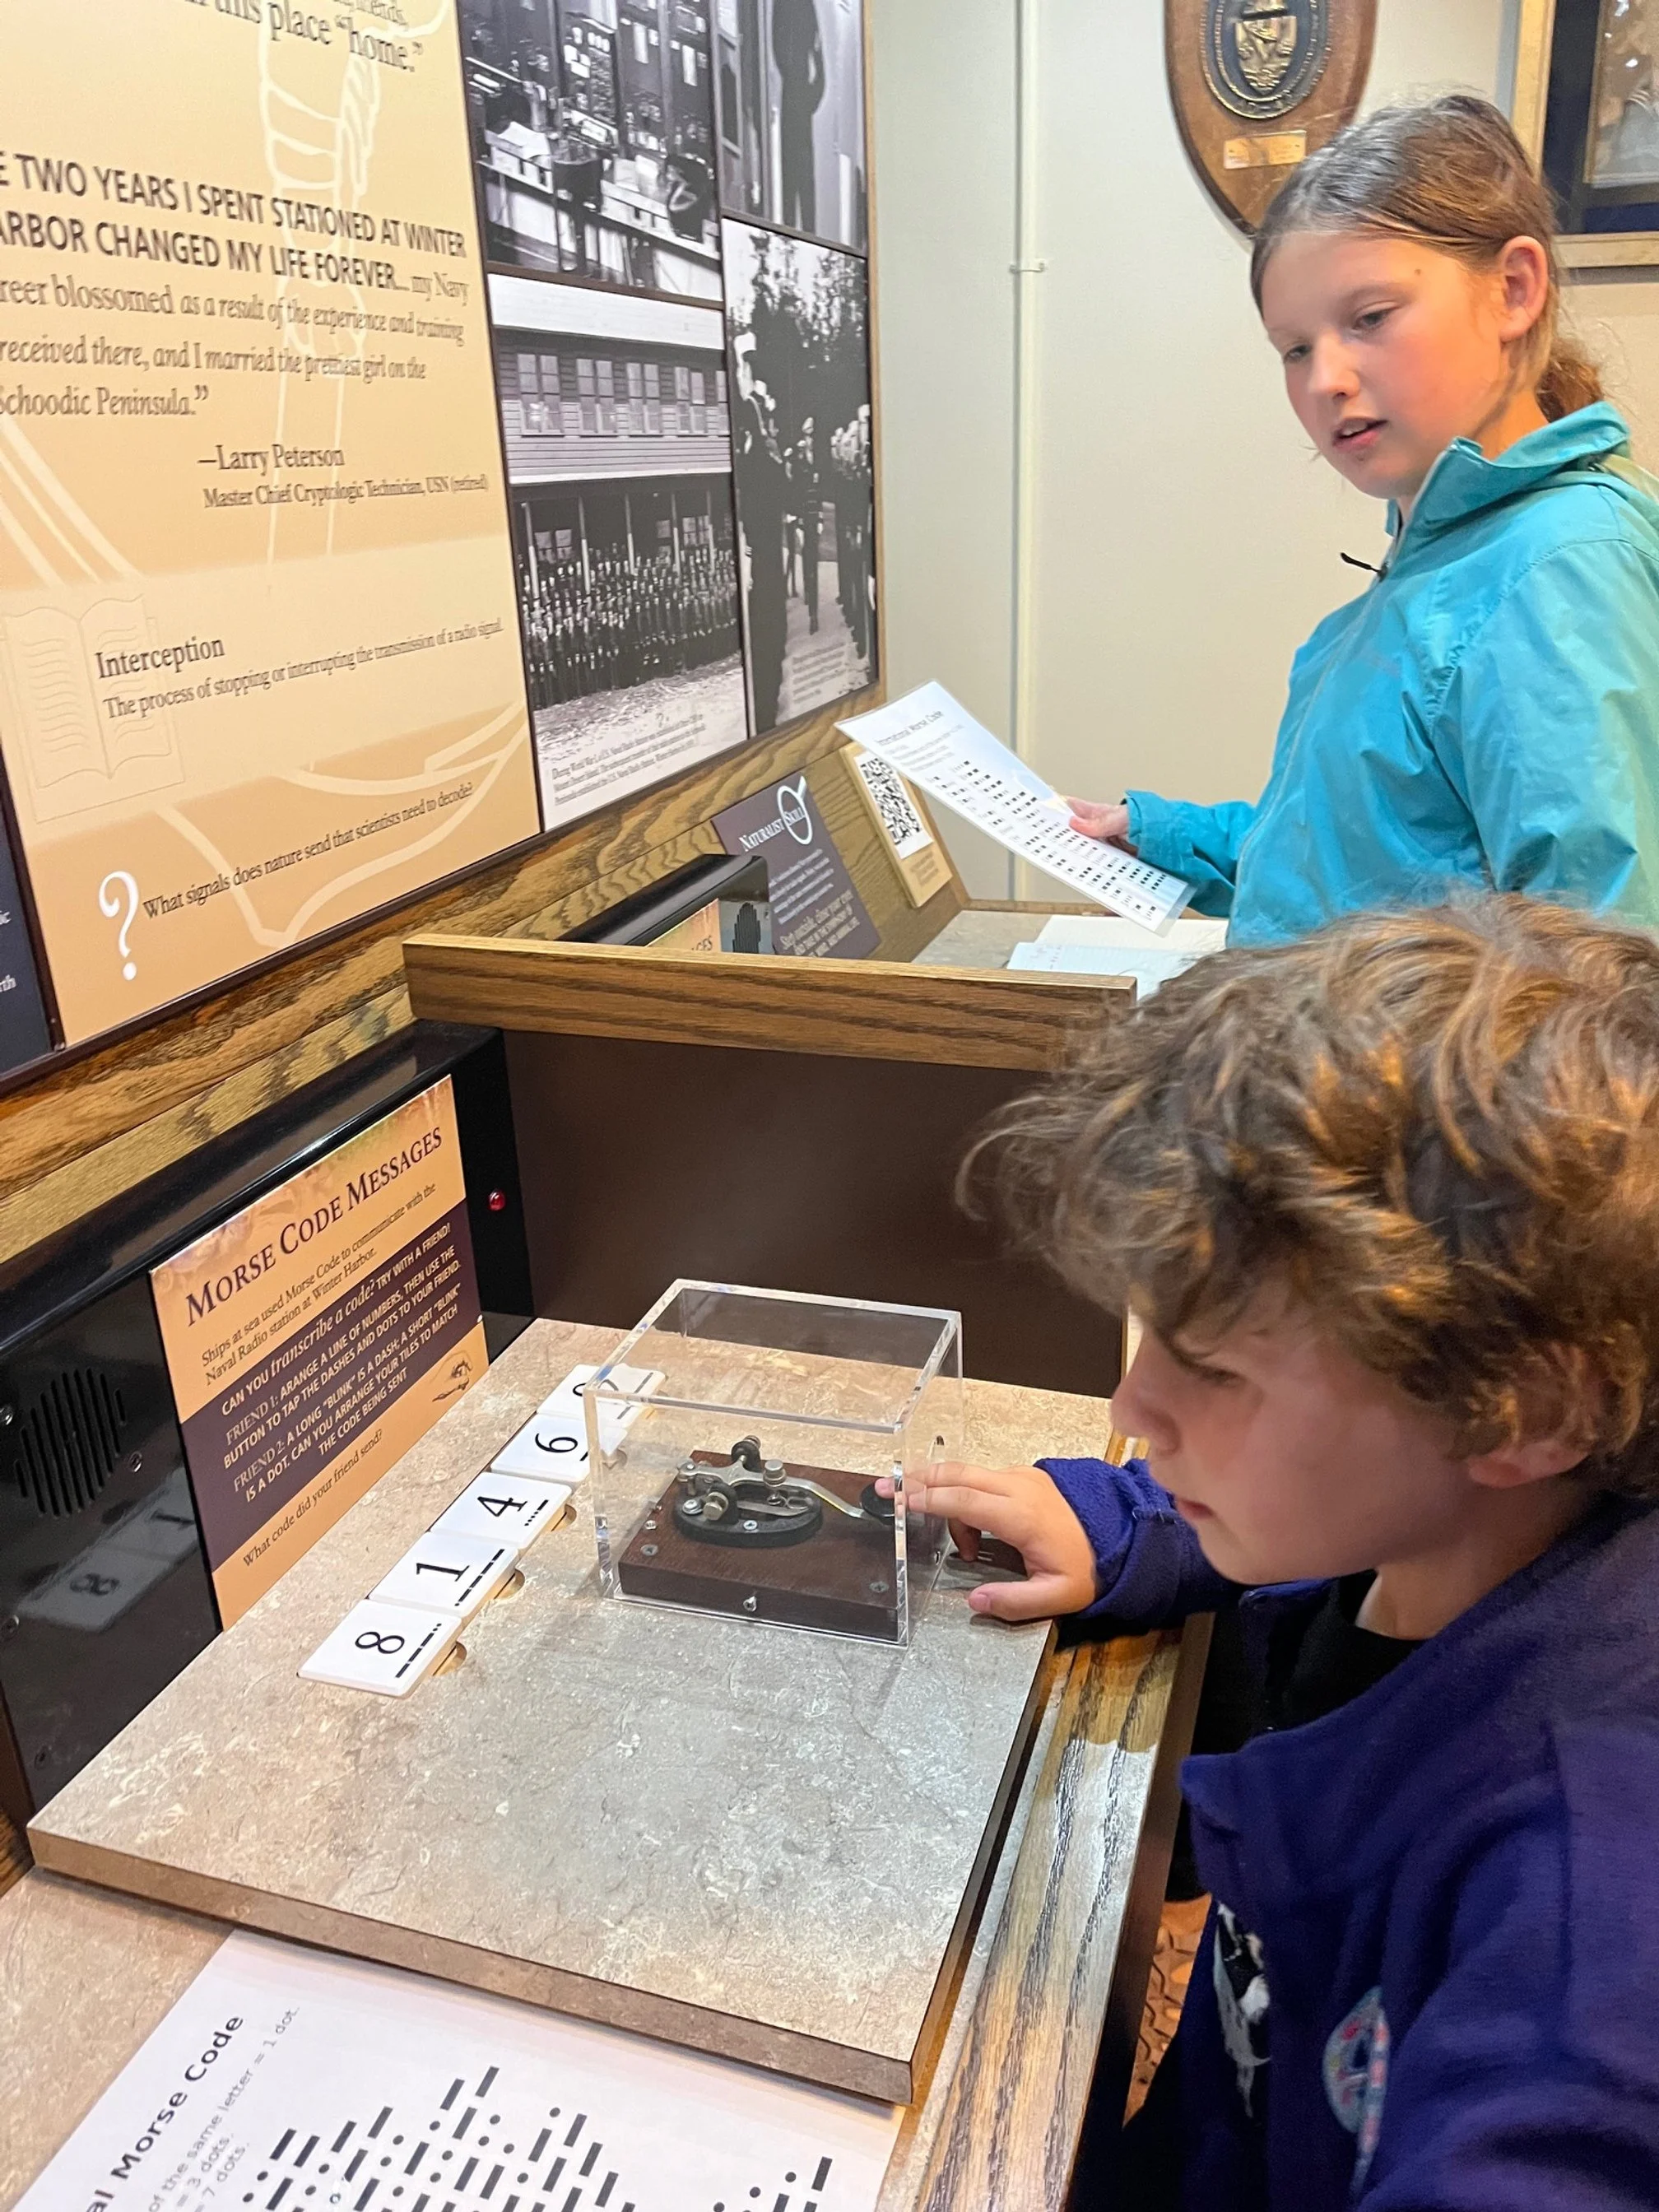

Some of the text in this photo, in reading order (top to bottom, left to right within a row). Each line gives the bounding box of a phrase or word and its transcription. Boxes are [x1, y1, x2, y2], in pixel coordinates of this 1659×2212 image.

[268, 0, 332, 44] place
[12, 153, 87, 197] TWO
[93, 165, 179, 210] YEARS
[183, 181, 193, 213] I
[197, 184, 264, 224] SPENT
[270, 197, 376, 242] STATIONED
[381, 218, 401, 247] AT
[404, 222, 467, 258] WINTER
[50, 273, 175, 314] blossomed
[180, 294, 200, 315] as
[203, 297, 216, 316] a
[219, 294, 264, 321] result
[267, 296, 286, 331] of
[286, 296, 310, 325] the
[313, 305, 387, 334] experience
[389, 311, 414, 333] and
[95, 221, 470, 307] CHANGED MY LIFE Navy
[0, 333, 87, 364] received
[92, 336, 150, 371] there,
[153, 341, 190, 368] and
[205, 346, 275, 372] married
[278, 347, 302, 373] the
[363, 354, 386, 384] girl
[388, 361, 406, 379] on
[407, 356, 426, 379] the
[203, 486, 253, 508] Master
[256, 483, 292, 504] Chief
[272, 444, 346, 469] Peterson
[94, 635, 225, 679] Interception
[102, 696, 137, 719] The
[138, 685, 195, 718] process
[196, 677, 212, 699] of
[213, 669, 272, 698] stopping
[272, 667, 286, 683] or
[287, 651, 356, 679] interrupting
[356, 645, 374, 663] the
[142, 781, 473, 919] What signals does nature send that scientists need decode?
[185, 1127, 442, 1327] MORSE CODE MESSAGES
[202, 1183, 437, 1367] Ships at sea used Morse Code to communicate with the
[206, 1248, 377, 1386] Naval Radio station at Winter Harbor.
[221, 1222, 451, 1415] CAN YOU transcribe a code? TRY WITH A FRIEND!
[224, 1260, 462, 1469] BUTTON TO TAP THE DASHES AND DOTS TO YOUR FRIEND.
[225, 1244, 455, 1446] FRIEND ARANGE A LINE OF NUMBERS, THEN USE THE
[234, 1448, 276, 1492] FRIEND
[287, 1431, 295, 1446] A
[295, 1406, 322, 1437] LONG
[357, 1367, 365, 1382] IS
[367, 1361, 374, 1374] A
[401, 1331, 408, 1345] A
[407, 1307, 433, 1337] SHORT
[246, 1304, 458, 1503] IS A DOT. CAN YOU ARRANGE YOUR TILES TO MATCH
[318, 1367, 407, 1456] THE CODE BEING SENT
[534, 1433, 579, 1454] 6
[243, 1429, 383, 1567] What code did your friend send?
[476, 1494, 528, 1517] 4
[415, 1561, 470, 1582] 1
[354, 1630, 405, 1654] 8
[110, 2016, 244, 2181] Morse Code
[162, 2006, 301, 2192] the same letter 1 dot.
[188, 2177, 201, 2189] 3
[200, 2133, 235, 2173] dots.
[202, 2143, 250, 2199] 7 dots.
